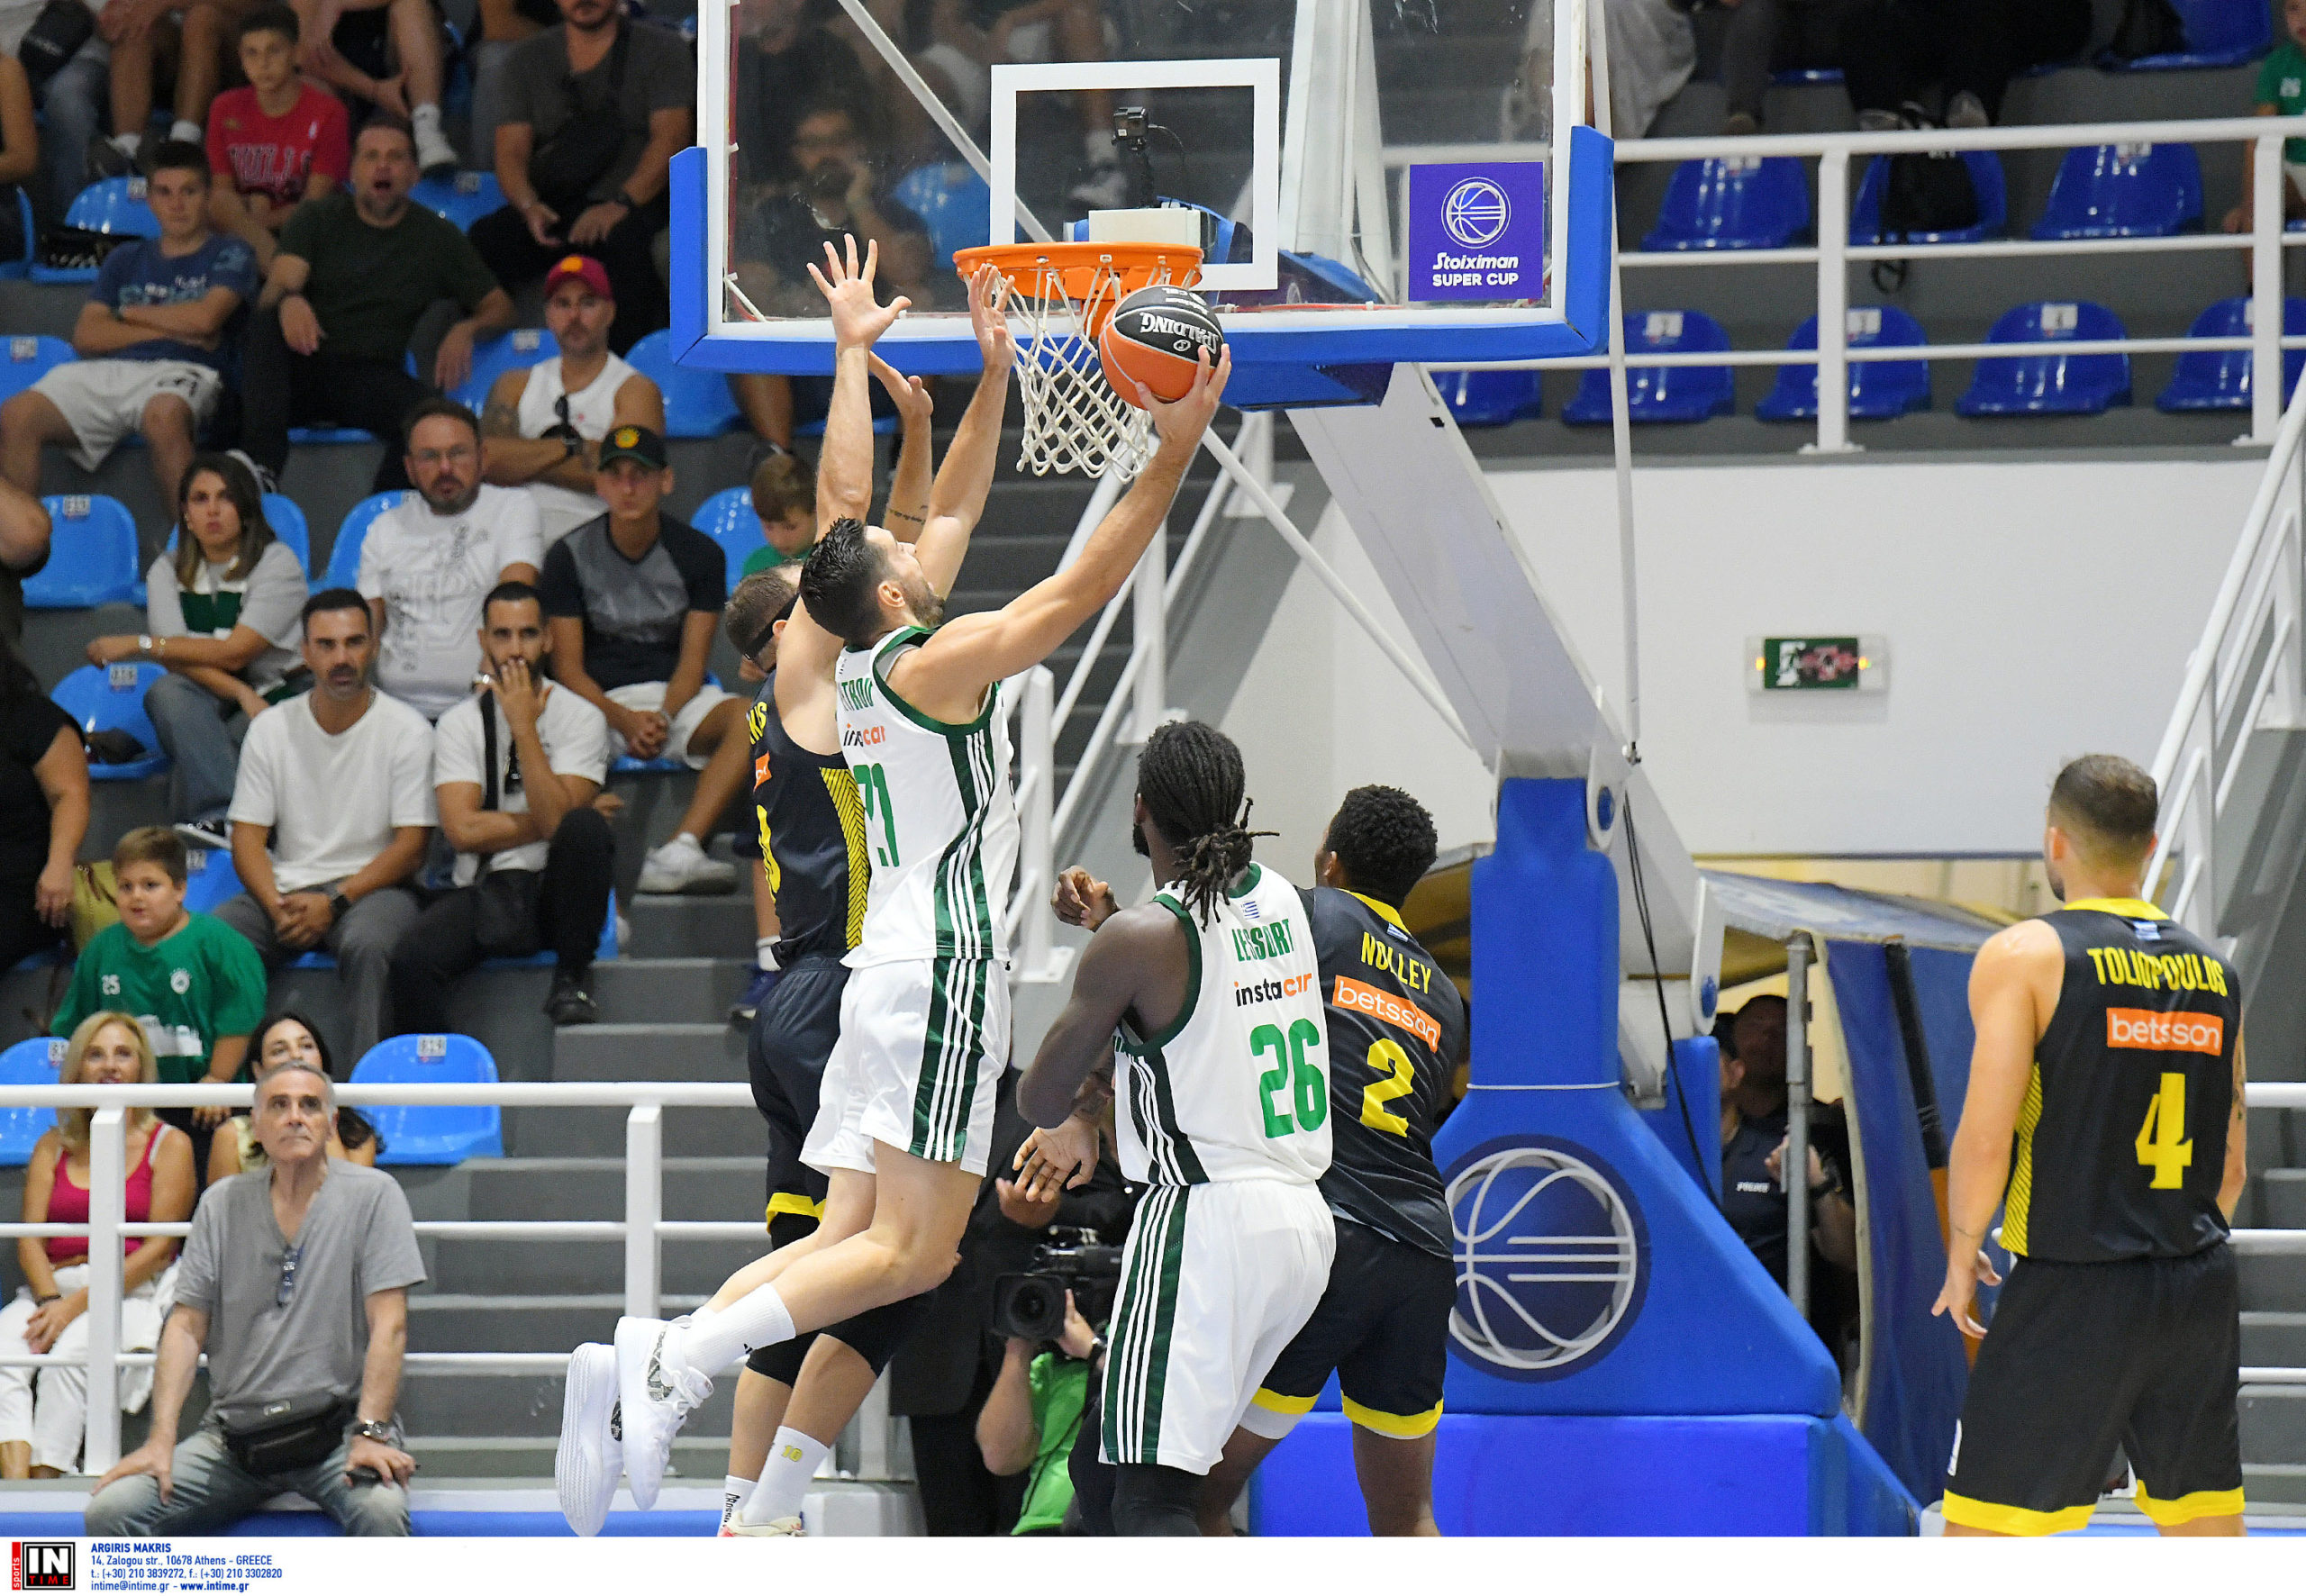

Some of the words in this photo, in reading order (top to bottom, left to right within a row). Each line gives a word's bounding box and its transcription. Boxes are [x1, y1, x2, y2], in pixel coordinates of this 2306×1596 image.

[1432, 252, 1520, 270] Stoiximan
[1432, 274, 1483, 287] SUPER
[1486, 273, 1520, 286] CUP
[1361, 931, 1431, 994] NOLLEY
[1338, 980, 1437, 1047] betsson
[2111, 1012, 2220, 1049] betsson
[1249, 1018, 1328, 1138] 26
[1359, 1038, 1415, 1138] 2
[2135, 1072, 2193, 1189] 4
